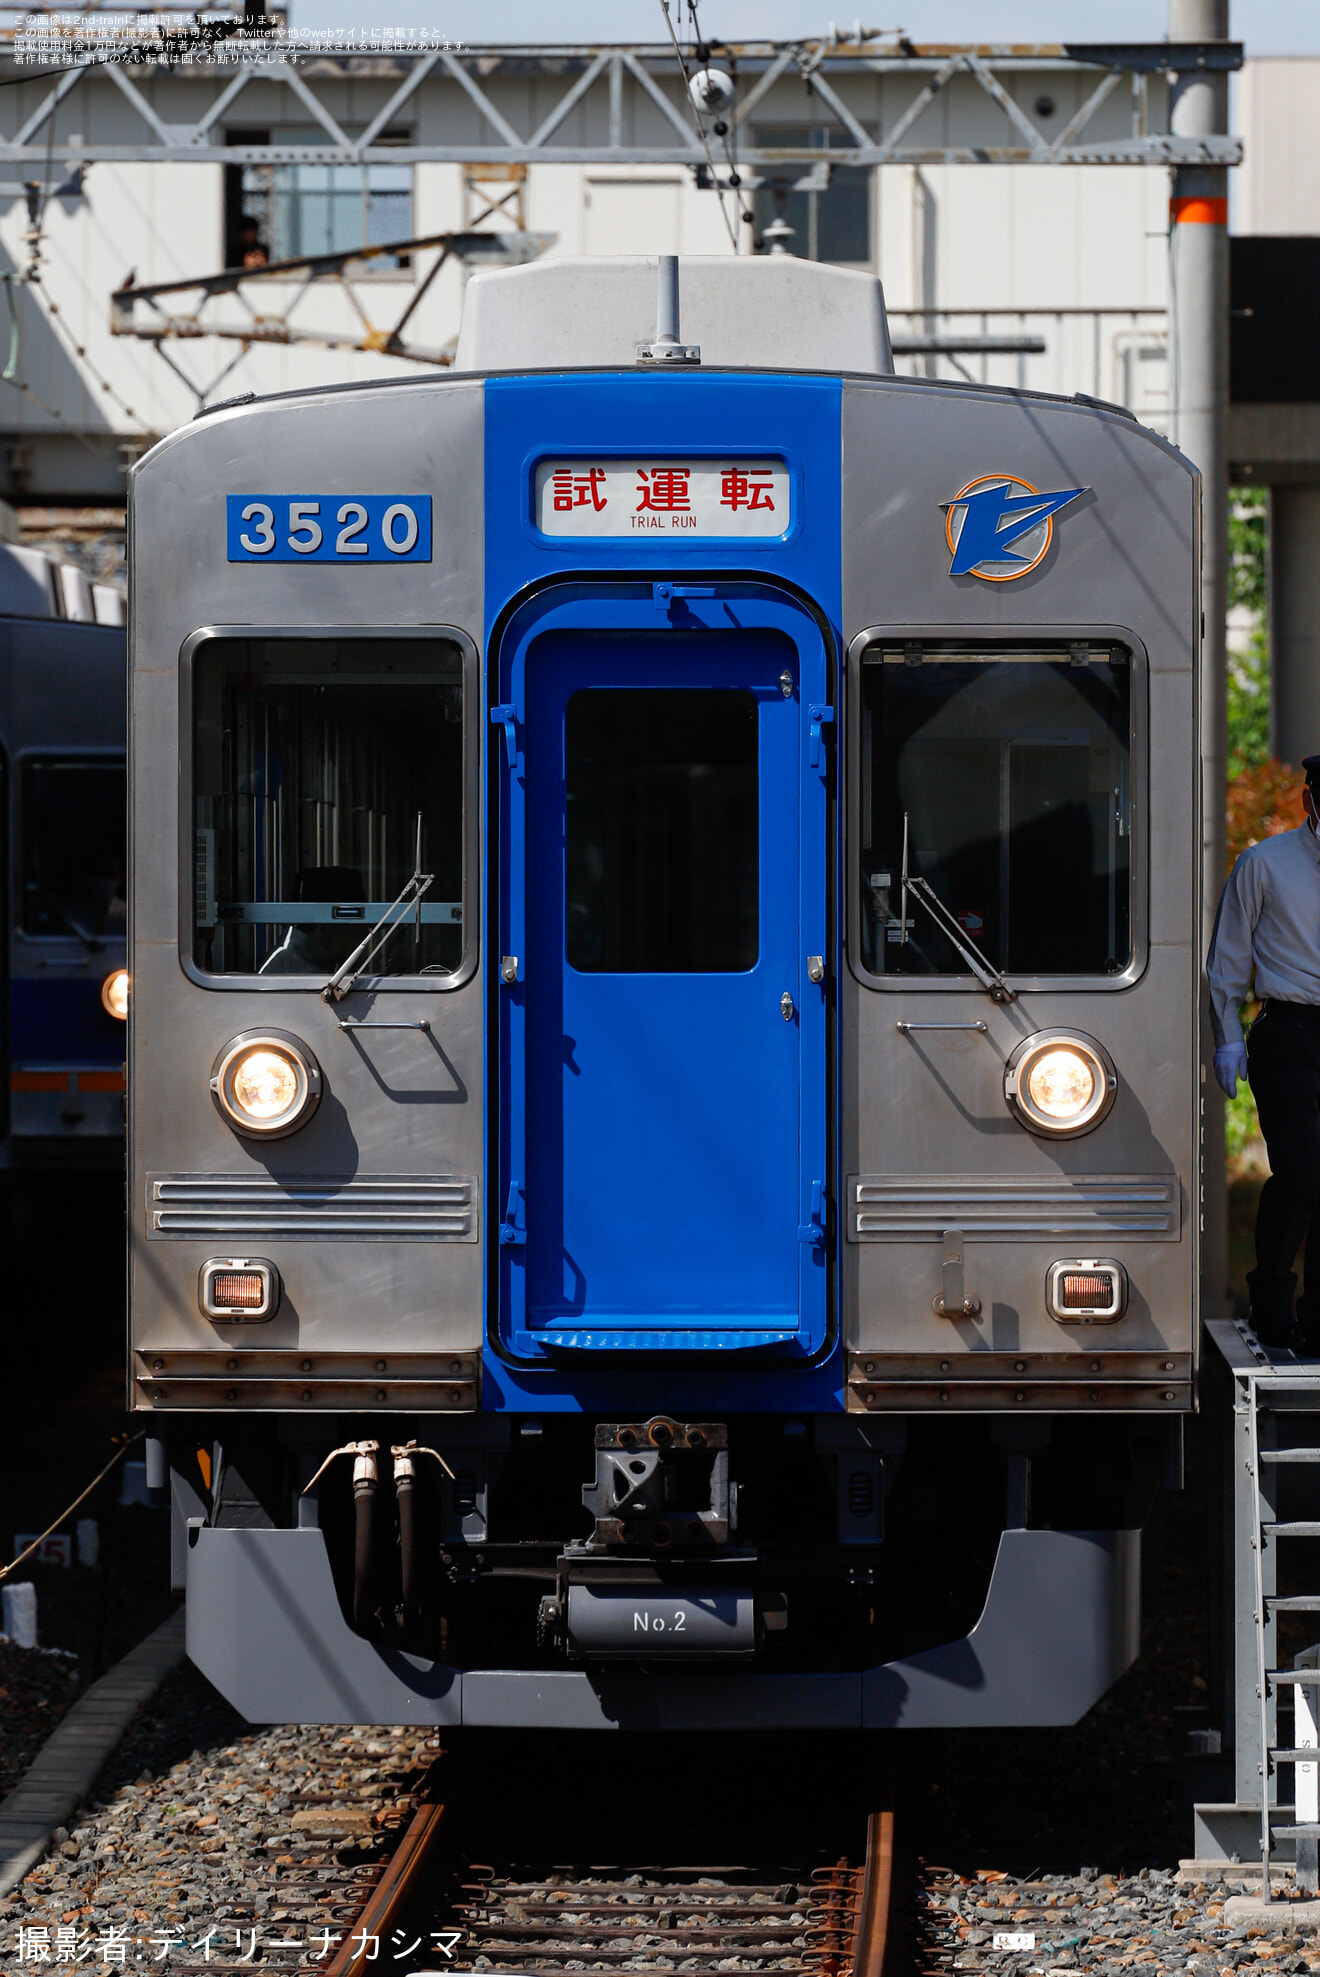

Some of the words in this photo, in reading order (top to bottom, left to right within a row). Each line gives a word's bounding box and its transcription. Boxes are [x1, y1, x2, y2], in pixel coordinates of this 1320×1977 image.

[552, 467, 775, 511] 試運転
[240, 503, 418, 553] 3520
[630, 516, 666, 528] TRIAL
[671, 516, 697, 528] RUN
[633, 1611, 687, 1632] No.2
